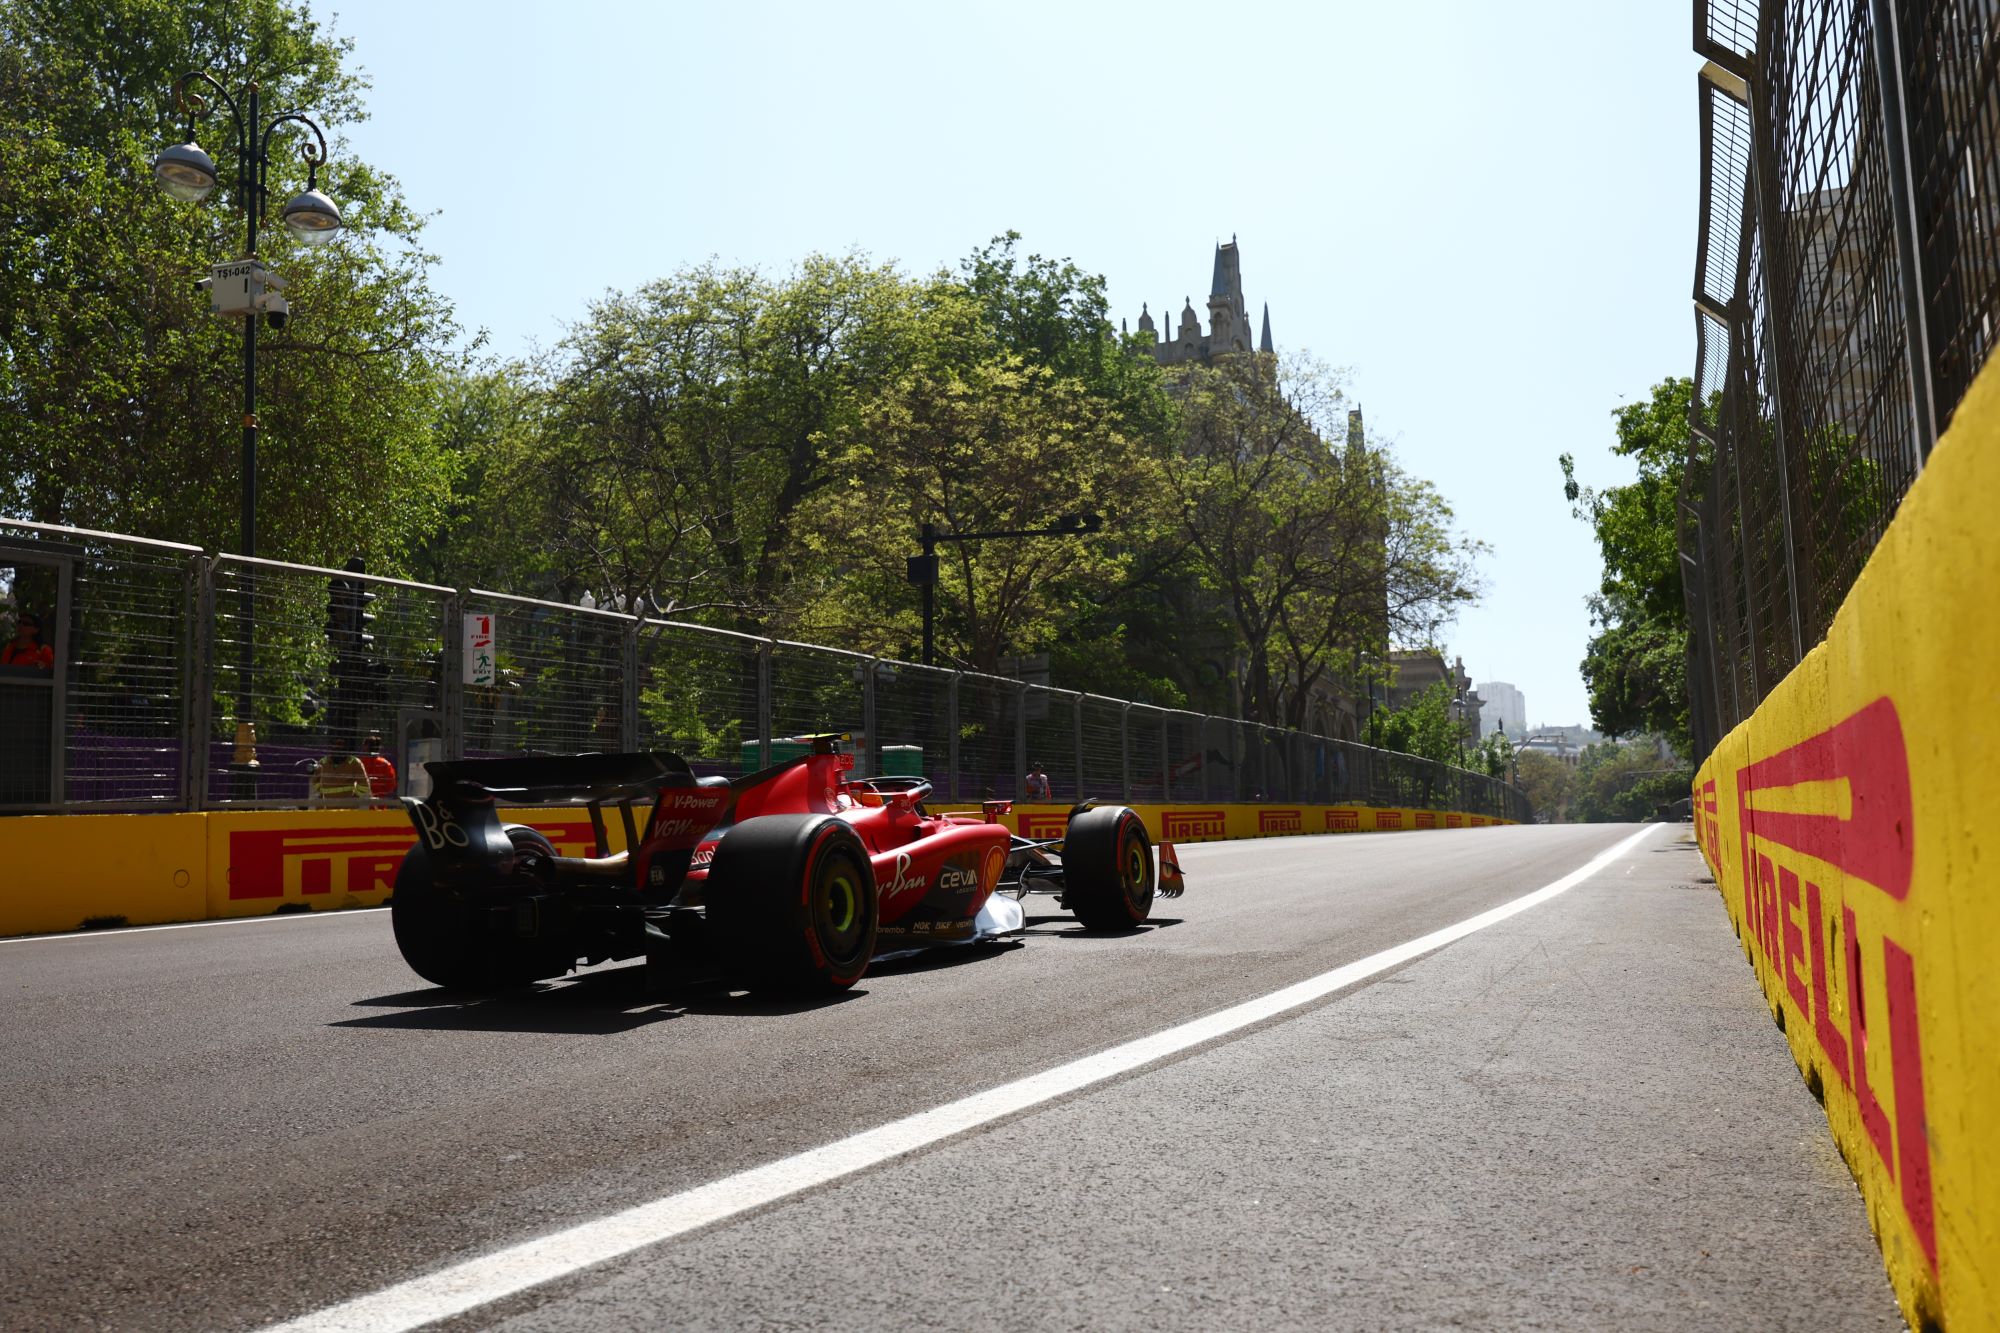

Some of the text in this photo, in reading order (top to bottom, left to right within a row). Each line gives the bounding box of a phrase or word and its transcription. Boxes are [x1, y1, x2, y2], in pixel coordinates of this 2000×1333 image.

[674, 795, 719, 809] V-Power
[1161, 811, 1225, 839] PIRELLI
[1258, 810, 1301, 833] PIRELLI
[1325, 810, 1359, 829] PIRELLI
[876, 852, 925, 900] y-Ban
[1736, 696, 1939, 1282] PIRELLI
